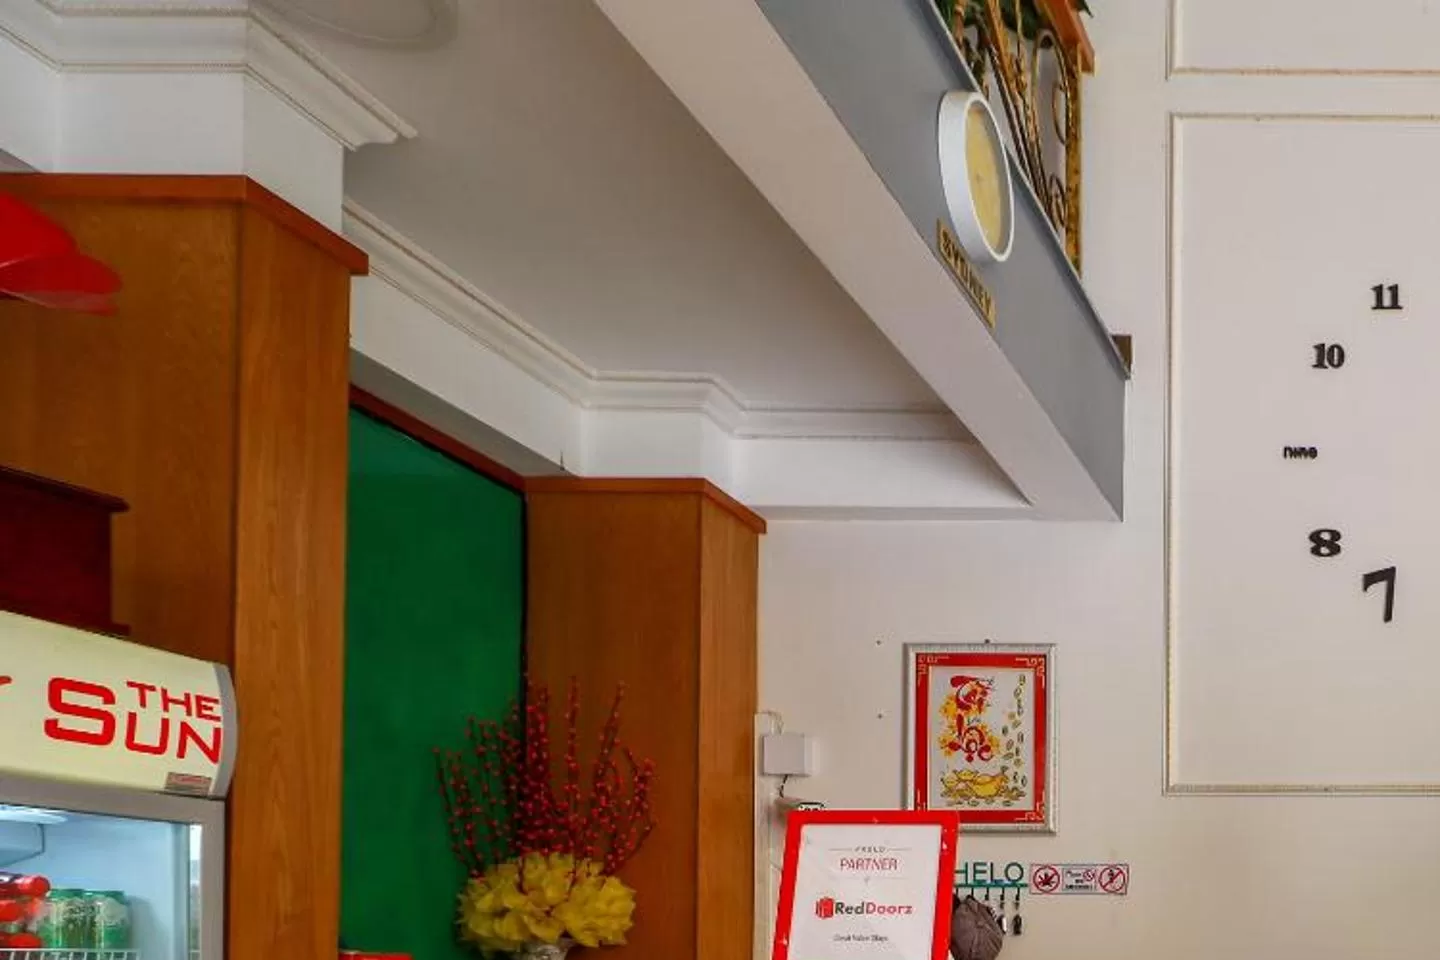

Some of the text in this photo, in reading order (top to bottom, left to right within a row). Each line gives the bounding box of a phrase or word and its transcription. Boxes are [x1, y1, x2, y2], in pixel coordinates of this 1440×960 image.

[1371, 283, 1403, 310] 11
[1312, 343, 1345, 370] 10
[1308, 528, 1342, 558] 8
[1362, 566, 1397, 623] 7
[125, 680, 222, 722] THE
[44, 677, 223, 764] SUN
[840, 858, 898, 871] PARTNER
[834, 901, 913, 915] RedDoorz
